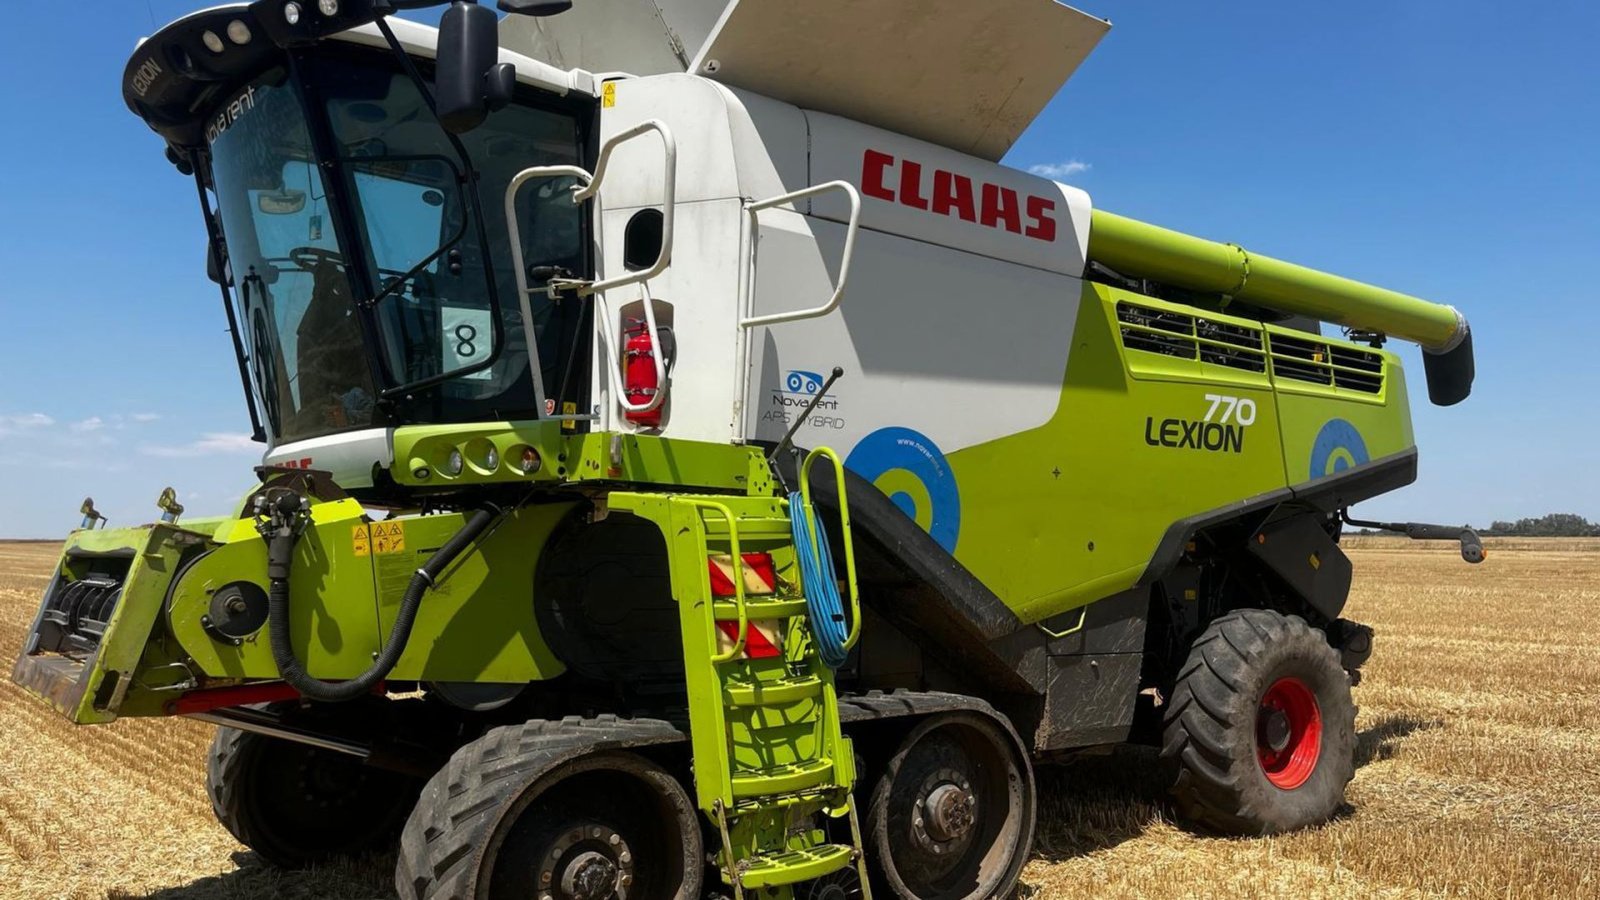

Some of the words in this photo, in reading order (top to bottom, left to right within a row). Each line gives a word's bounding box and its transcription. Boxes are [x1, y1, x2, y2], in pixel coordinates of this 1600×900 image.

[131, 56, 162, 97] LEXION
[861, 149, 1056, 242] CLAAS
[455, 324, 476, 357] 8
[773, 395, 838, 410] Novaent
[1203, 393, 1256, 426] 770
[1145, 416, 1244, 453] LEXION
